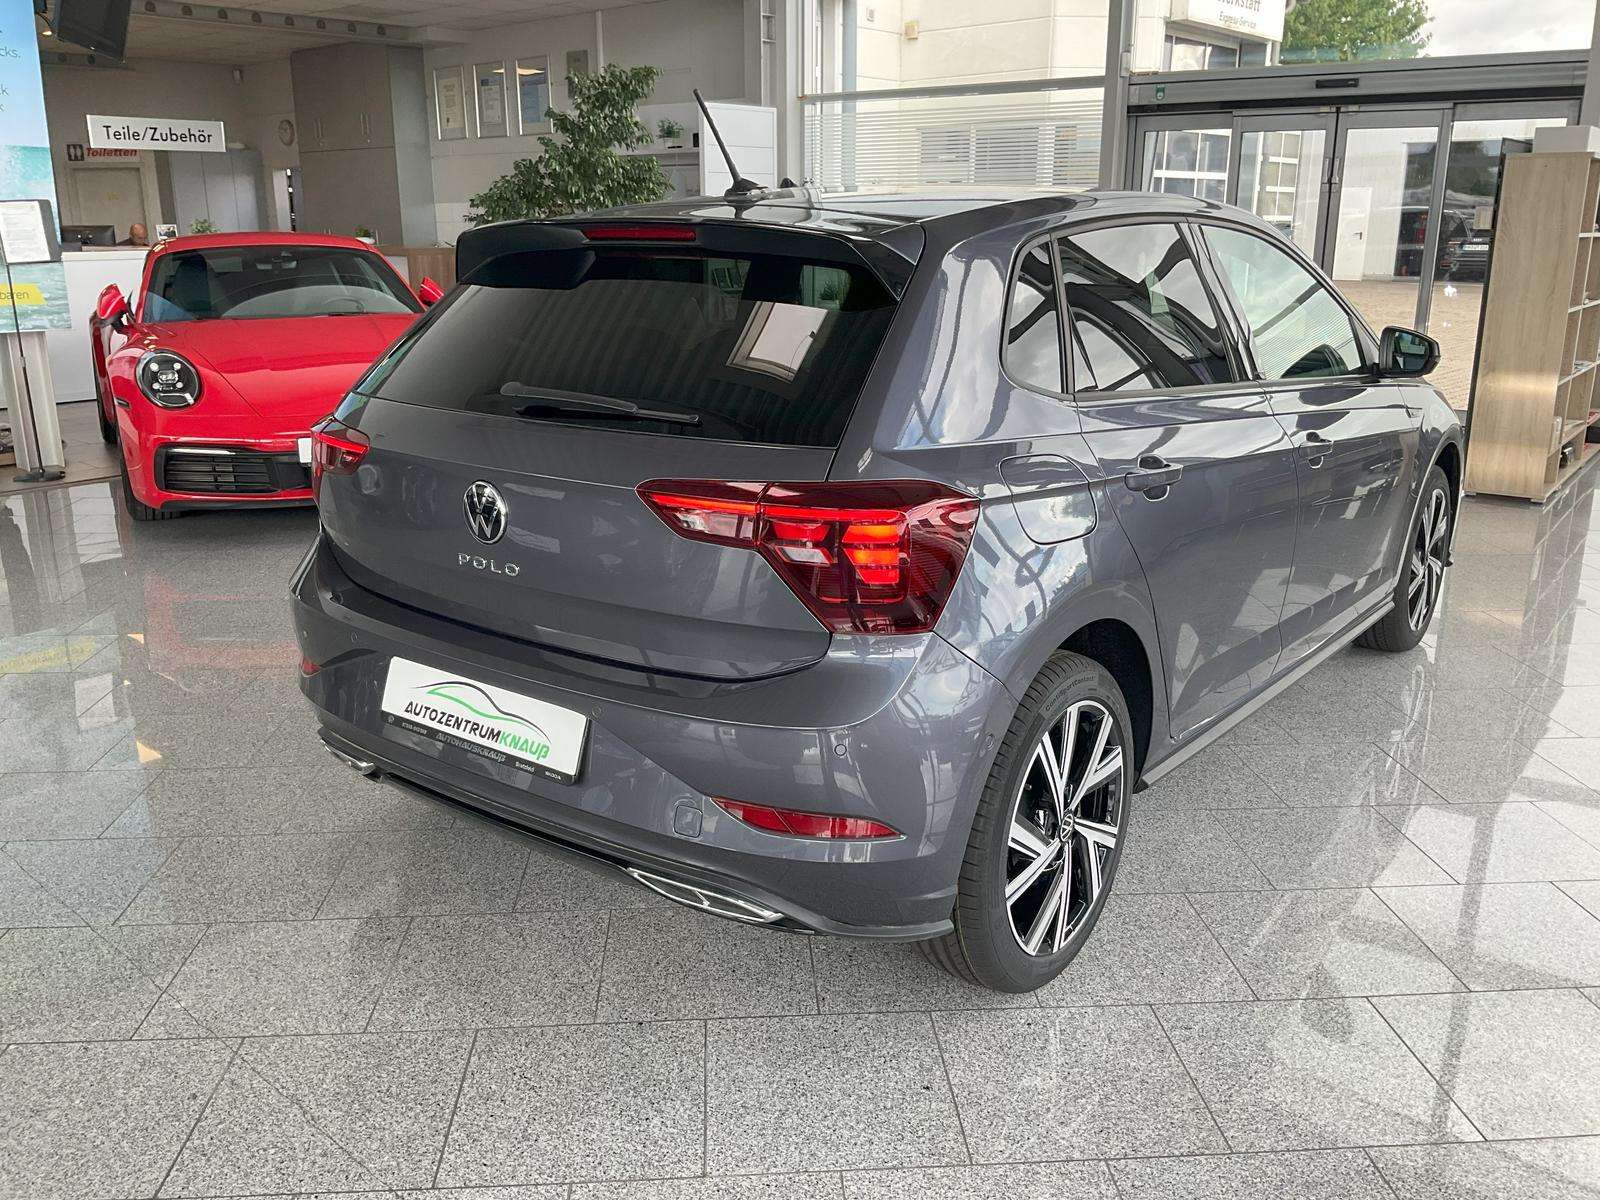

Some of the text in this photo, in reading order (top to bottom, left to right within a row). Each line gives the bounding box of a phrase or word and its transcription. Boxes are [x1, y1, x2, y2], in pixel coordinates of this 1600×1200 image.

[103, 125, 213, 144] Teile/Zubehör
[86, 147, 138, 158] Toiletten
[457, 552, 520, 577] POLO
